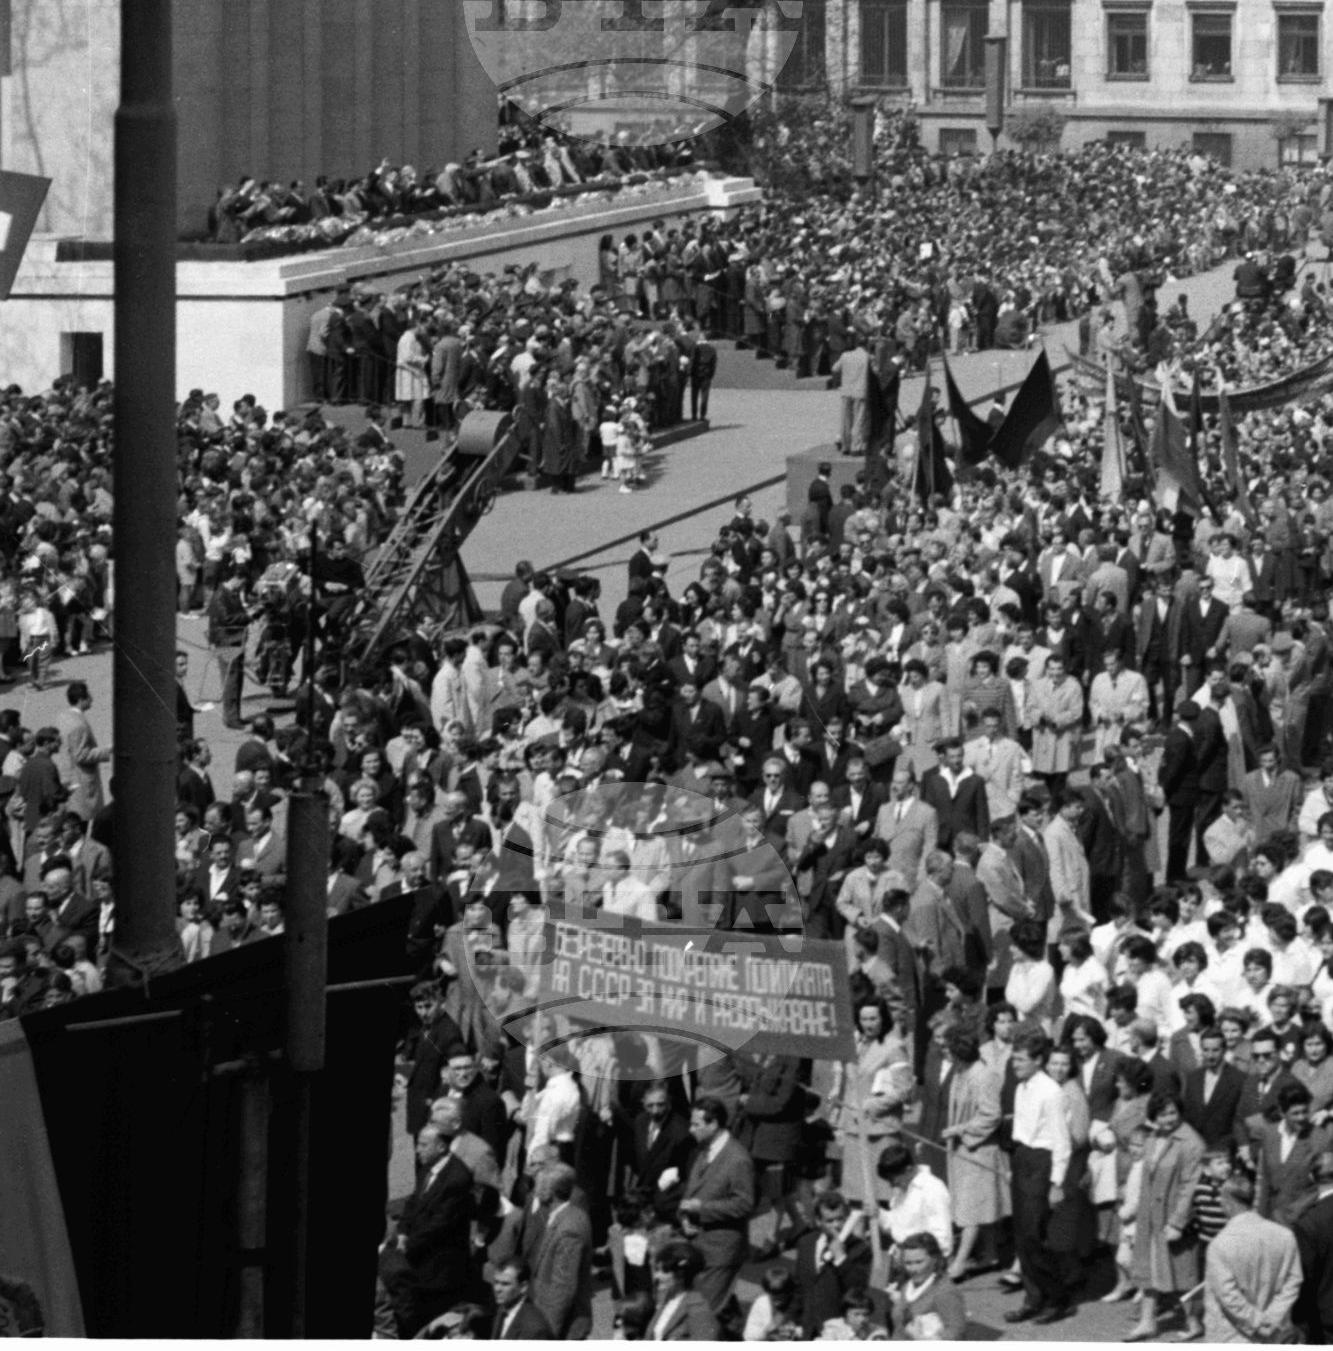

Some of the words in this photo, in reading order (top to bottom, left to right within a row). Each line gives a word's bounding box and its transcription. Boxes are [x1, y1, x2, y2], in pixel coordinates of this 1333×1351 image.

[555, 922, 647, 974] БЕЗРЕЗЕРВНО
[552, 959, 571, 994] НА
[578, 965, 632, 1007] СССР
[635, 978, 656, 1015] ЗА
[660, 982, 688, 1021] МИР
[694, 990, 707, 1025] И
